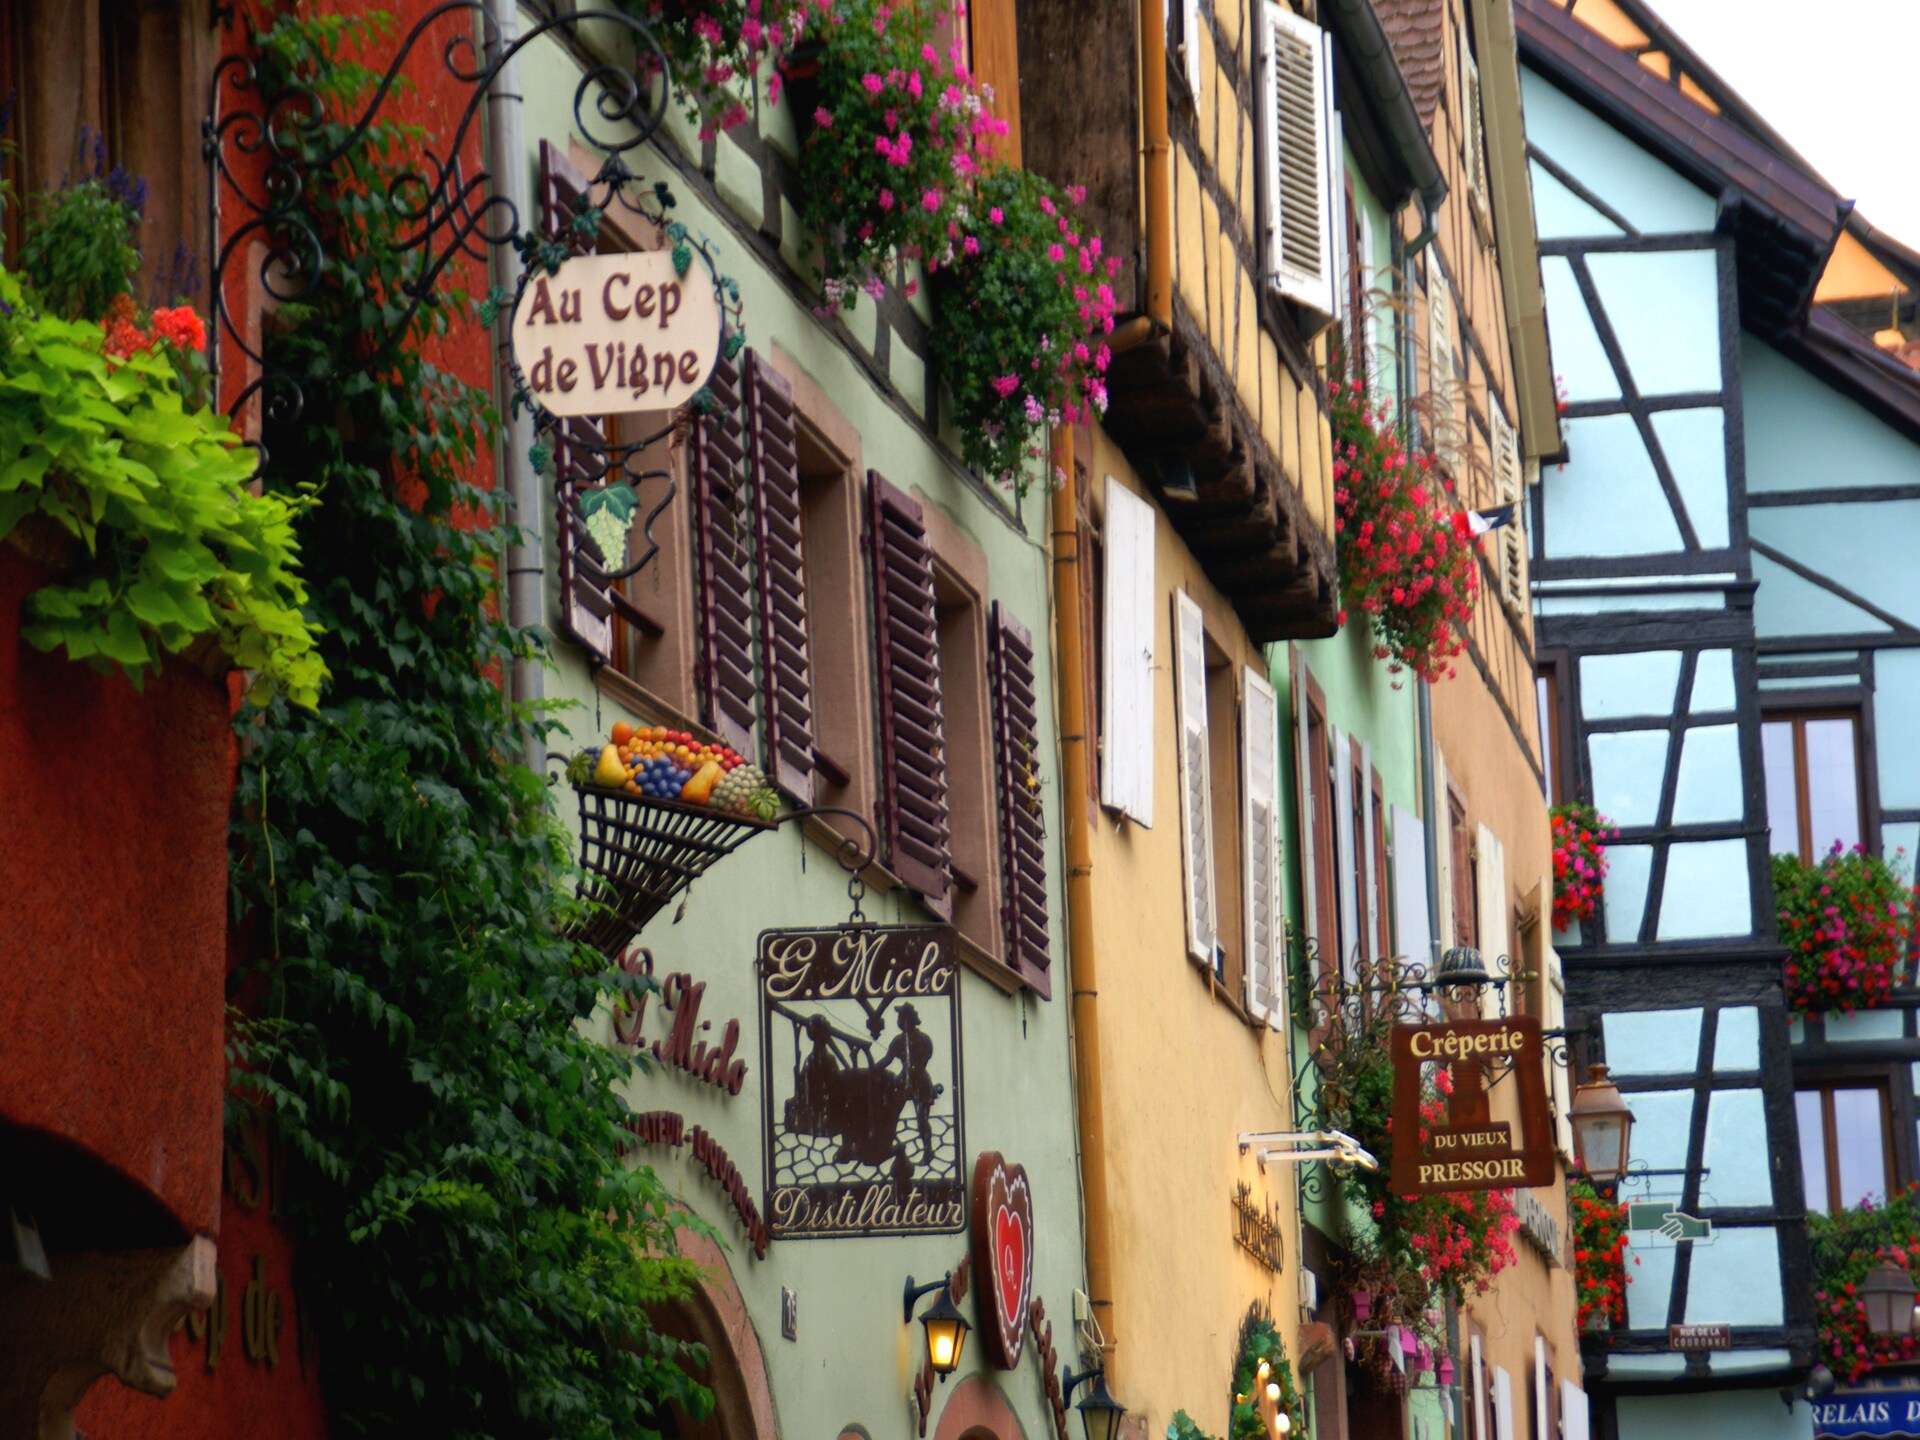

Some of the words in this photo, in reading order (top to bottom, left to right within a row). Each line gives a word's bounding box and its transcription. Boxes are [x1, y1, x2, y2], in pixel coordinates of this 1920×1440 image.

[526, 277, 583, 326] Au
[602, 272, 682, 329] Cep
[530, 346, 578, 393] de
[584, 341, 700, 400] Vigne
[819, 933, 955, 996] Miclo
[1410, 1026, 1524, 1061] Crêperie
[1434, 1134, 1458, 1149] DU
[1461, 1131, 1508, 1147] VIEUX
[1419, 1158, 1526, 1184] PRESSOIR
[772, 1183, 962, 1230] Distillateur
[1674, 1337, 1727, 1348] COURONNE
[1680, 1327, 1696, 1337] RUE
[1697, 1327, 1709, 1337] DE
[1710, 1327, 1721, 1337] LA
[1812, 1401, 1890, 1425] RELAIS
